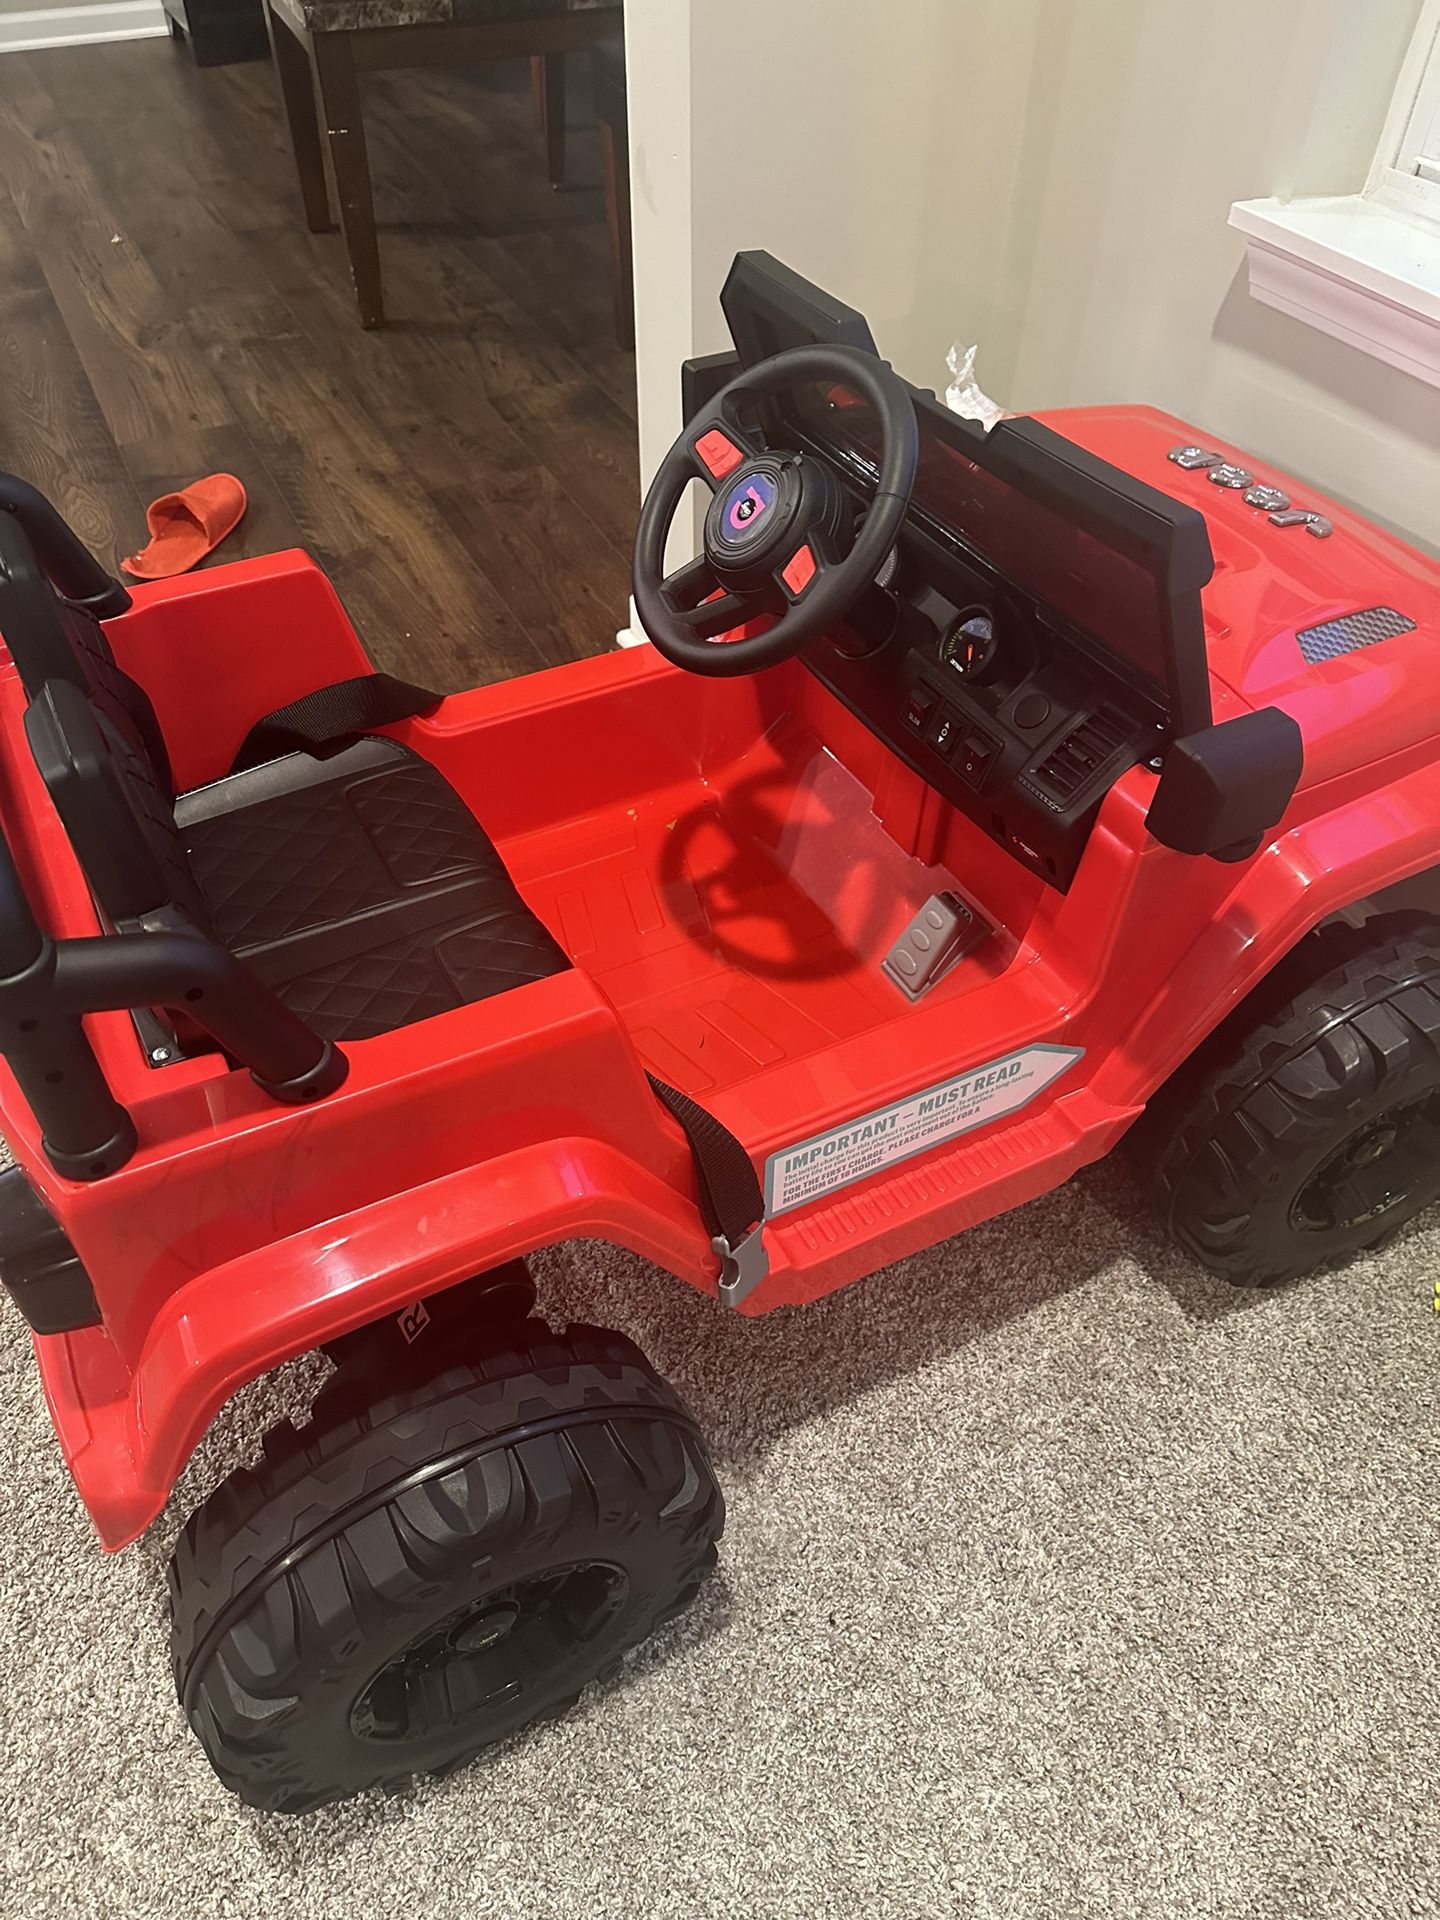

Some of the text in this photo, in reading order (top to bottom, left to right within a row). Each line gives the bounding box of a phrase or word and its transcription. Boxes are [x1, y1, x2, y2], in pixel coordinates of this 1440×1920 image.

[783, 1186, 801, 1197] FOR
[803, 1176, 822, 1188] THE
[821, 1166, 847, 1180] FIRST
[888, 1131, 920, 1151] PLEASE
[921, 1116, 957, 1136] CHARGE
[957, 1109, 974, 1120] FOR
[784, 1174, 797, 1182] The
[798, 1162, 819, 1176] initial
[820, 1151, 844, 1167] charge
[846, 1146, 856, 1156] for
[857, 1141, 870, 1150] this
[871, 1129, 898, 1145] product
[907, 1120, 921, 1129] very
[967, 1089, 989, 1102] ensure
[995, 1071, 1034, 1090] long-lasting
[784, 1173, 810, 1188] battery
[811, 1167, 823, 1176] life
[834, 1157, 847, 1168] you
[847, 1152, 860, 1161] can
[861, 1144, 873, 1155] get
[874, 1140, 885, 1149] the
[886, 1133, 903, 1144] most
[904, 1116, 939, 1136] enjoyment
[952, 1107, 959, 1115] of
[960, 1102, 971, 1111] the
[785, 1113, 899, 1173] IMPORTANT
[918, 1082, 971, 1116] MUST
[973, 1061, 1022, 1092] READ
[783, 1156, 885, 1204] MINIMUM OF 18 HOURS.
